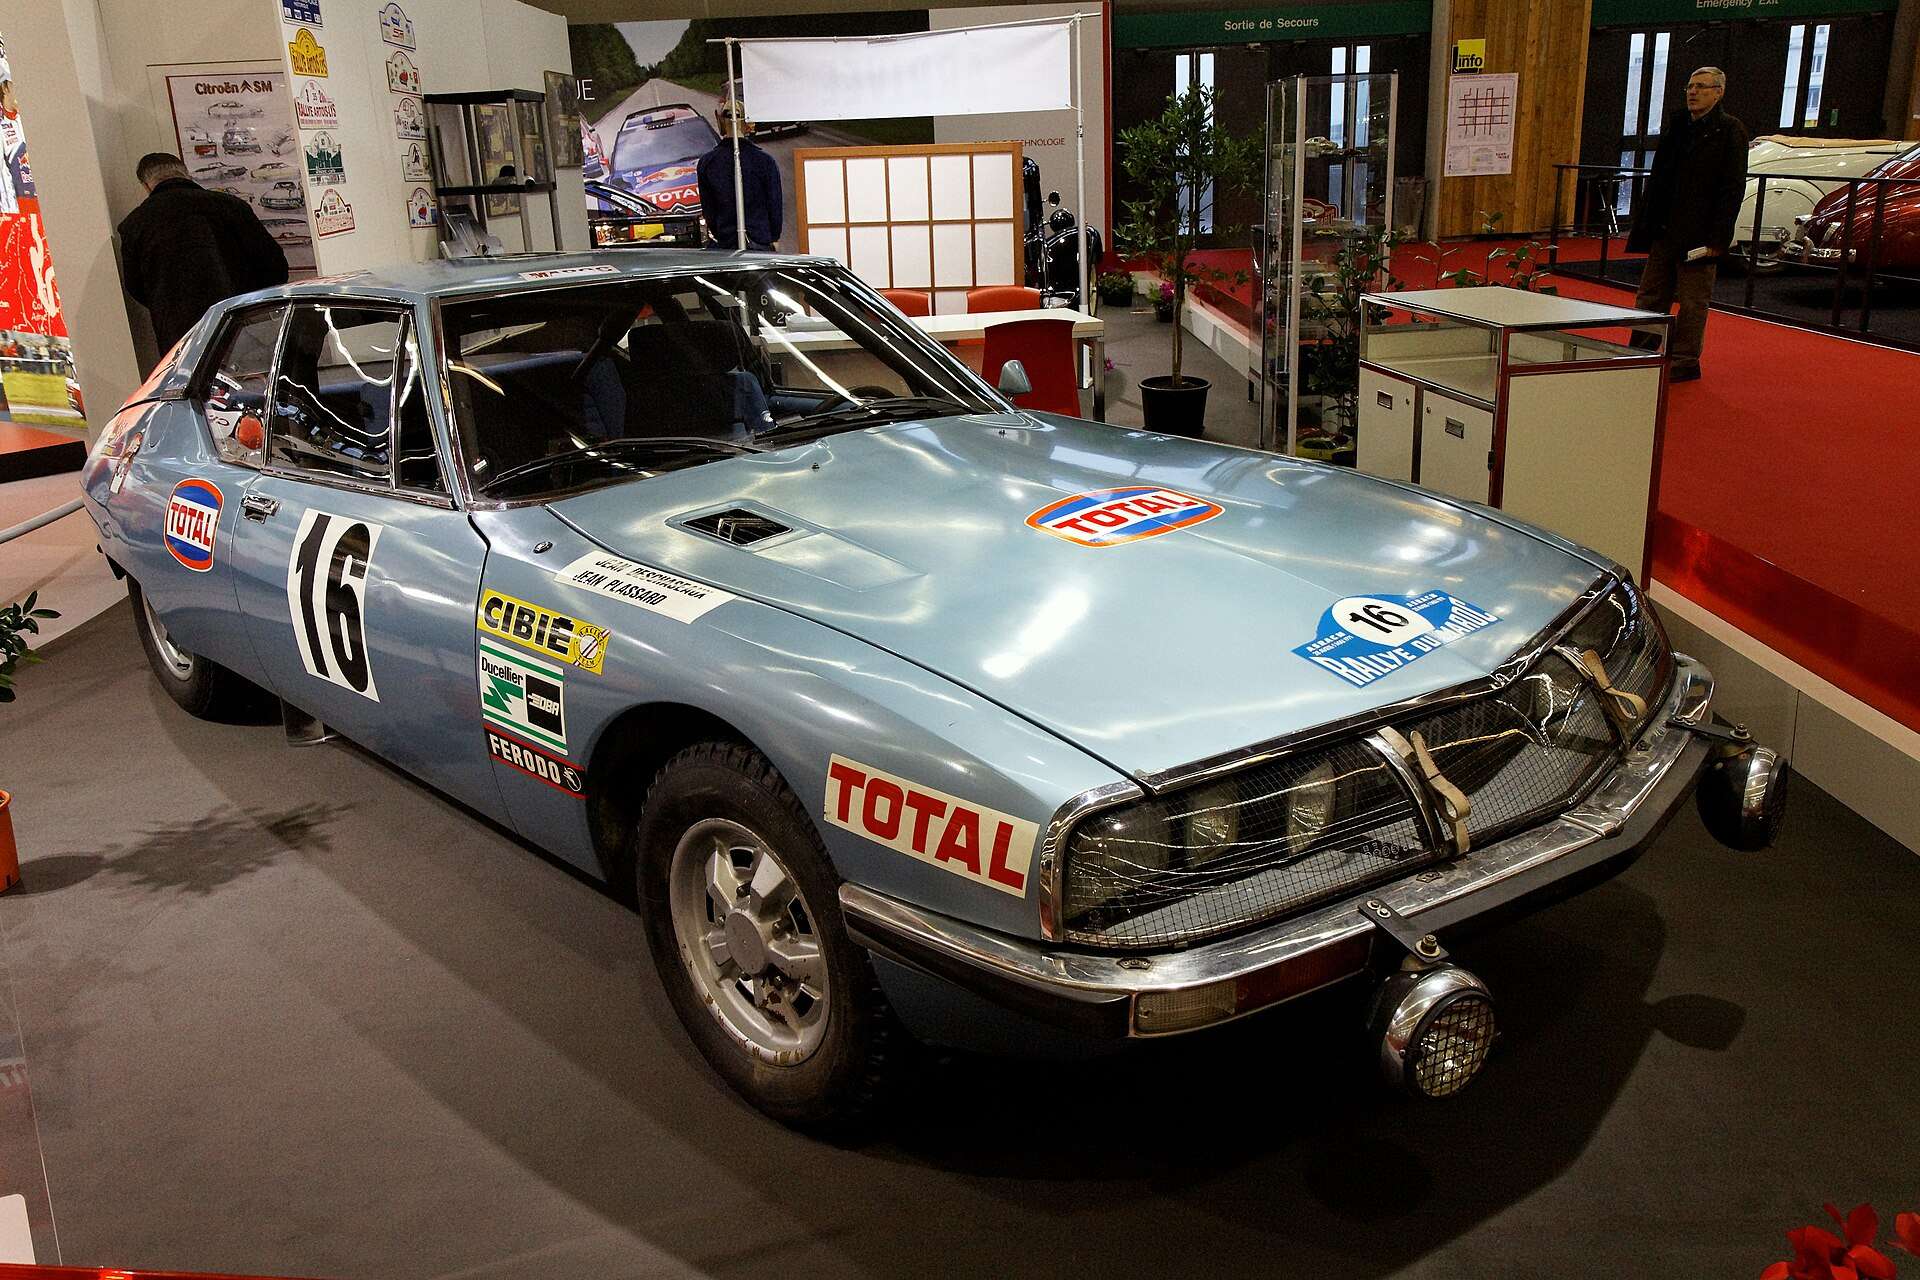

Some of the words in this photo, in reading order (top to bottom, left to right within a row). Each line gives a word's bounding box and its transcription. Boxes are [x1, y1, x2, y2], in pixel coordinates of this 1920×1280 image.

[1224, 20, 1255, 31] Sortie
[1259, 19, 1273, 29] de
[1277, 18, 1319, 29] Secours
[1459, 54, 1483, 67] info
[195, 82, 240, 95] Citroën
[253, 80, 273, 93] SM
[170, 502, 212, 547] TOTAL
[1052, 495, 1199, 535] TOTAL
[296, 513, 371, 692] 16
[572, 570, 607, 588] JEAN
[603, 578, 668, 606] PLASSARD
[1349, 604, 1410, 634] 16
[1308, 647, 1417, 686] RALLYE
[1410, 634, 1442, 653] DU
[1434, 596, 1499, 641] MAROC
[481, 656, 524, 686] Ducellier
[489, 733, 561, 784] FERODO
[829, 762, 1025, 891] TOTAL
